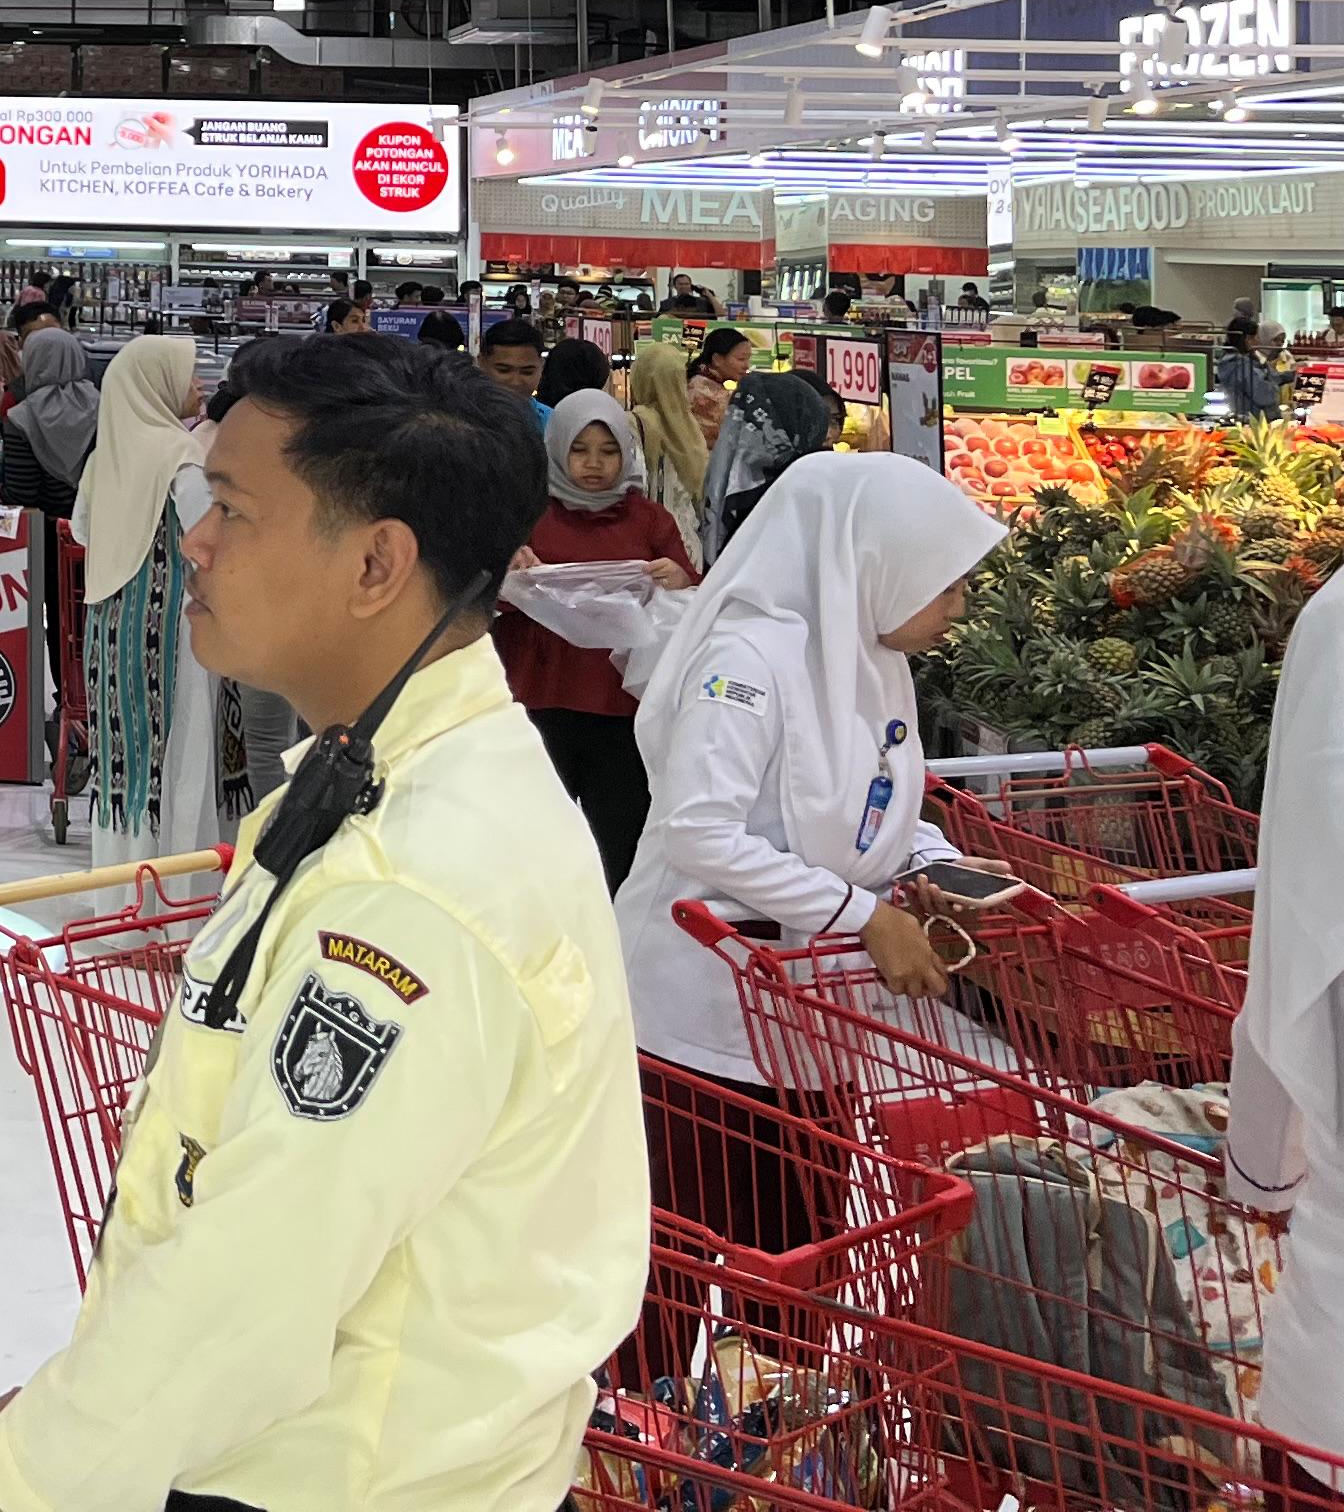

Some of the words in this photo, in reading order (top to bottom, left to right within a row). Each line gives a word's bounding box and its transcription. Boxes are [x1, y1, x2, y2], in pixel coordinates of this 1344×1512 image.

[16, 109, 94, 124] Rp300.000
[201, 122, 246, 133] JANGAN
[248, 122, 287, 133] BUANG
[201, 132, 238, 144] STRUK
[239, 133, 288, 144] BELANJA
[288, 134, 324, 145] KAMU
[378, 134, 421, 146] KUPON
[552, 114, 589, 160] MEA
[365, 147, 433, 159] POTONGAN
[39, 159, 87, 174] Untuk
[90, 161, 172, 176] Pembelian
[175, 162, 233, 177] Produk
[235, 164, 329, 180] YORIHADA
[354, 160, 390, 171] AKAN
[391, 161, 445, 173] MUNCUL
[377, 174, 390, 185] DI
[392, 174, 425, 186] EKOR
[39, 178, 120, 196] KITCHEN,
[123, 180, 191, 195] KOFFEA
[194, 182, 234, 197] Cafe
[238, 183, 251, 197] &
[255, 183, 314, 202] Bakery
[379, 186, 420, 198] STRUK
[541, 187, 626, 213] Quality
[640, 189, 761, 226] MEA
[1074, 183, 1190, 233] SEAFOOD
[1195, 186, 1266, 218] PRODUK
[1268, 182, 1316, 215] LAUT
[831, 197, 935, 222] AGING
[377, 317, 417, 326] SAYURAN
[828, 348, 877, 395] 1,990
[944, 366, 976, 381] PEL
[327, 938, 419, 997] MATARAM
